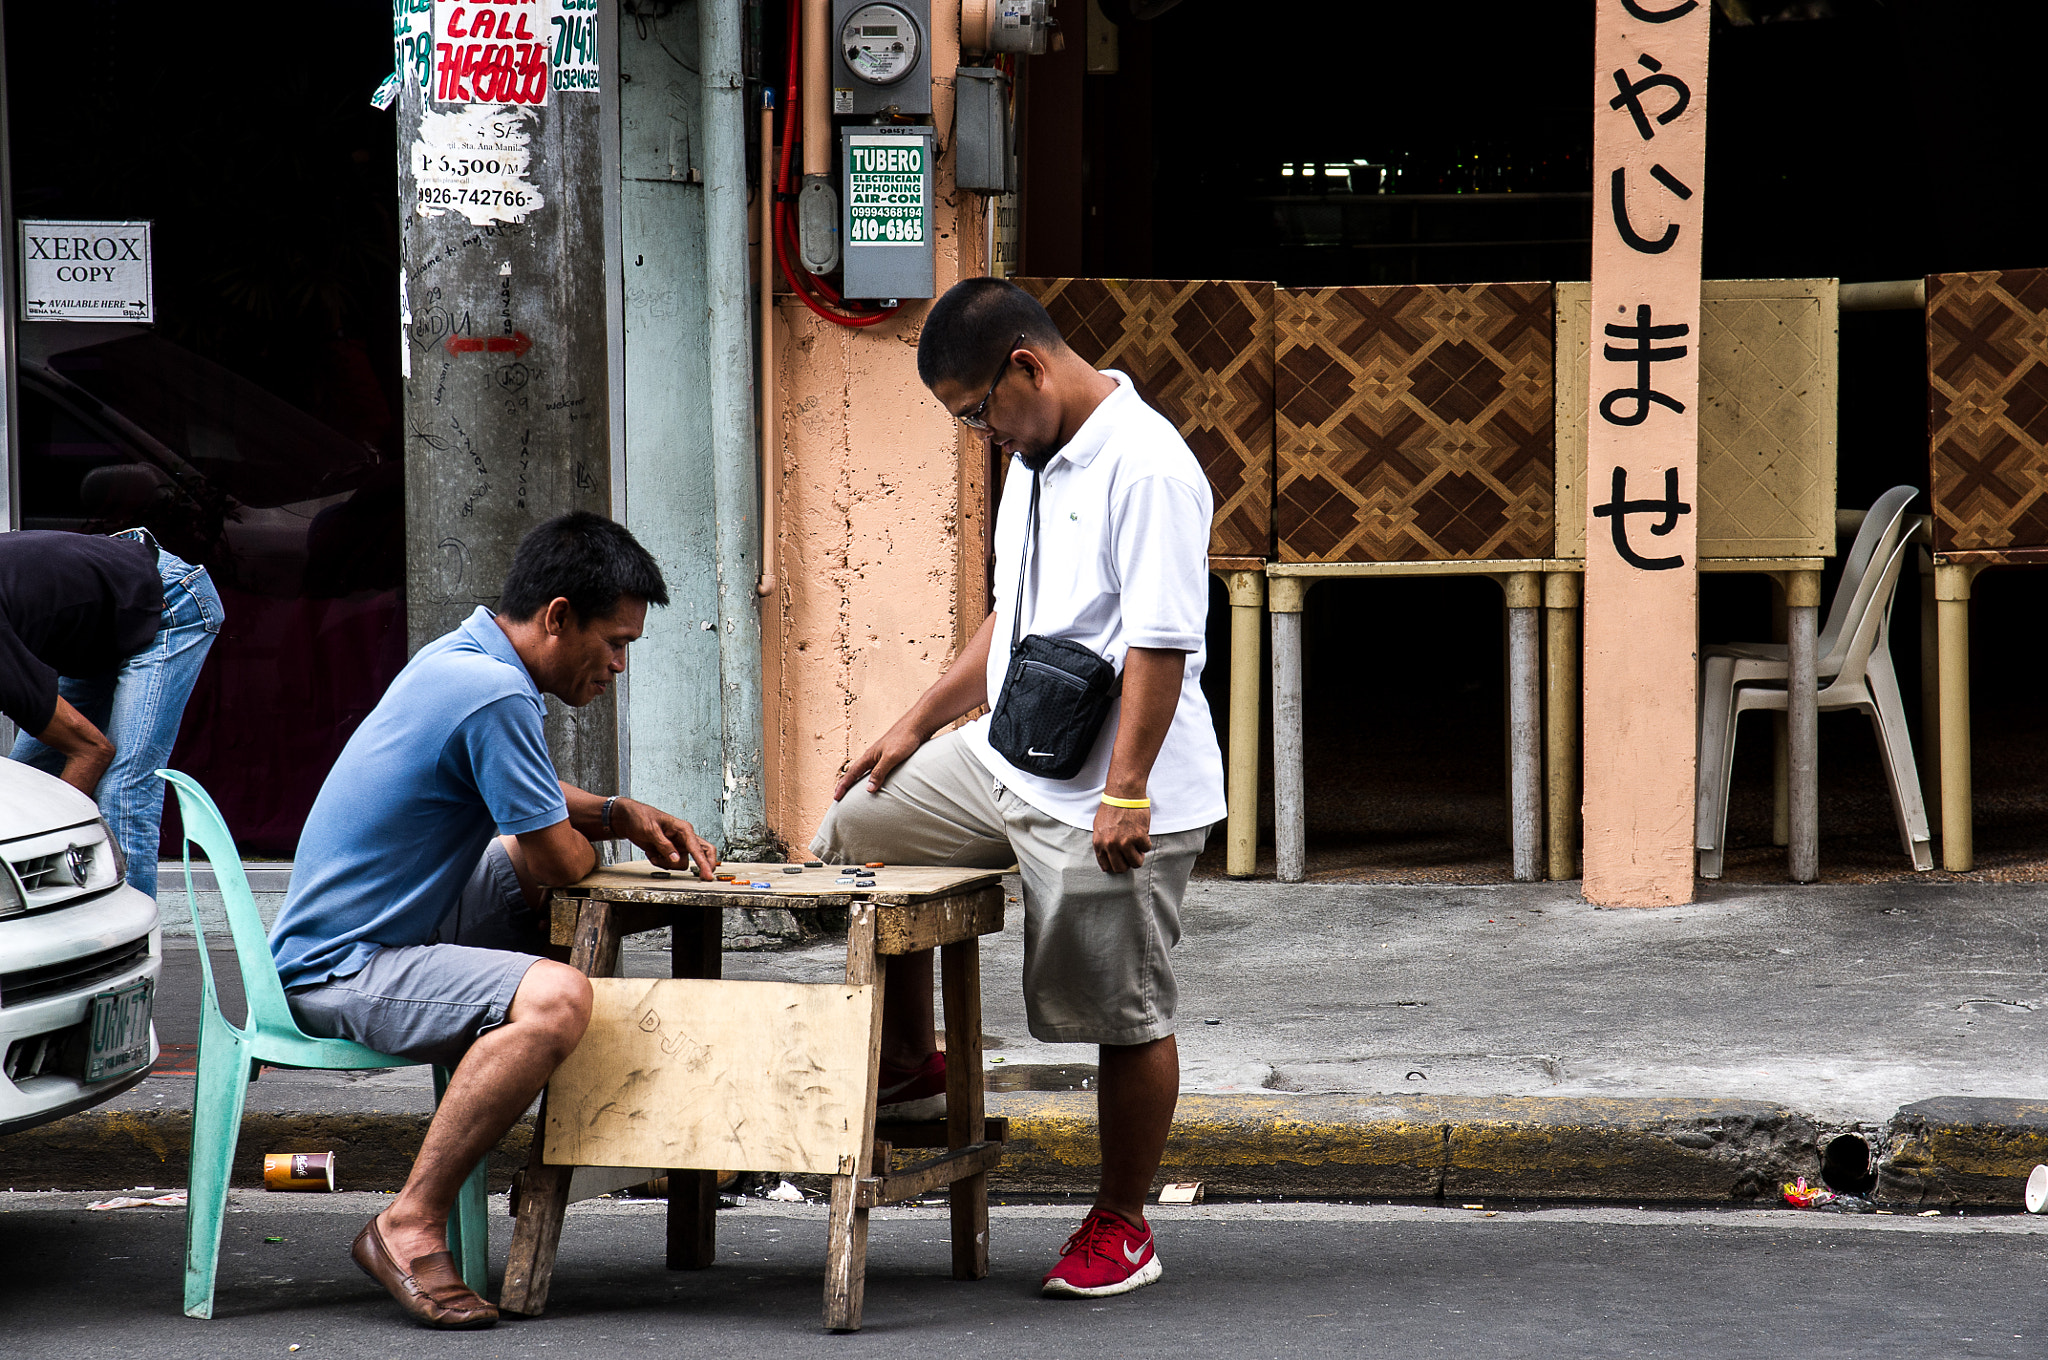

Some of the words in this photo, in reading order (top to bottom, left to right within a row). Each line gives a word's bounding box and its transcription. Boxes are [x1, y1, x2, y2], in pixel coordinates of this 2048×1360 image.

[447, 7, 534, 40] CALL
[478, 142, 493, 151] Ana
[853, 149, 921, 172] TUBERO
[853, 175, 921, 183] ELECTRICIAN
[853, 183, 921, 193] ZIPHONING
[853, 193, 921, 204] AIR-CON
[852, 207, 922, 218] 09994368194
[852, 218, 923, 241] 410-6365
[28, 236, 142, 261] XEROX
[56, 266, 116, 282] COPY
[48, 299, 99, 309] AVAILABLE
[100, 300, 126, 309] HERE
